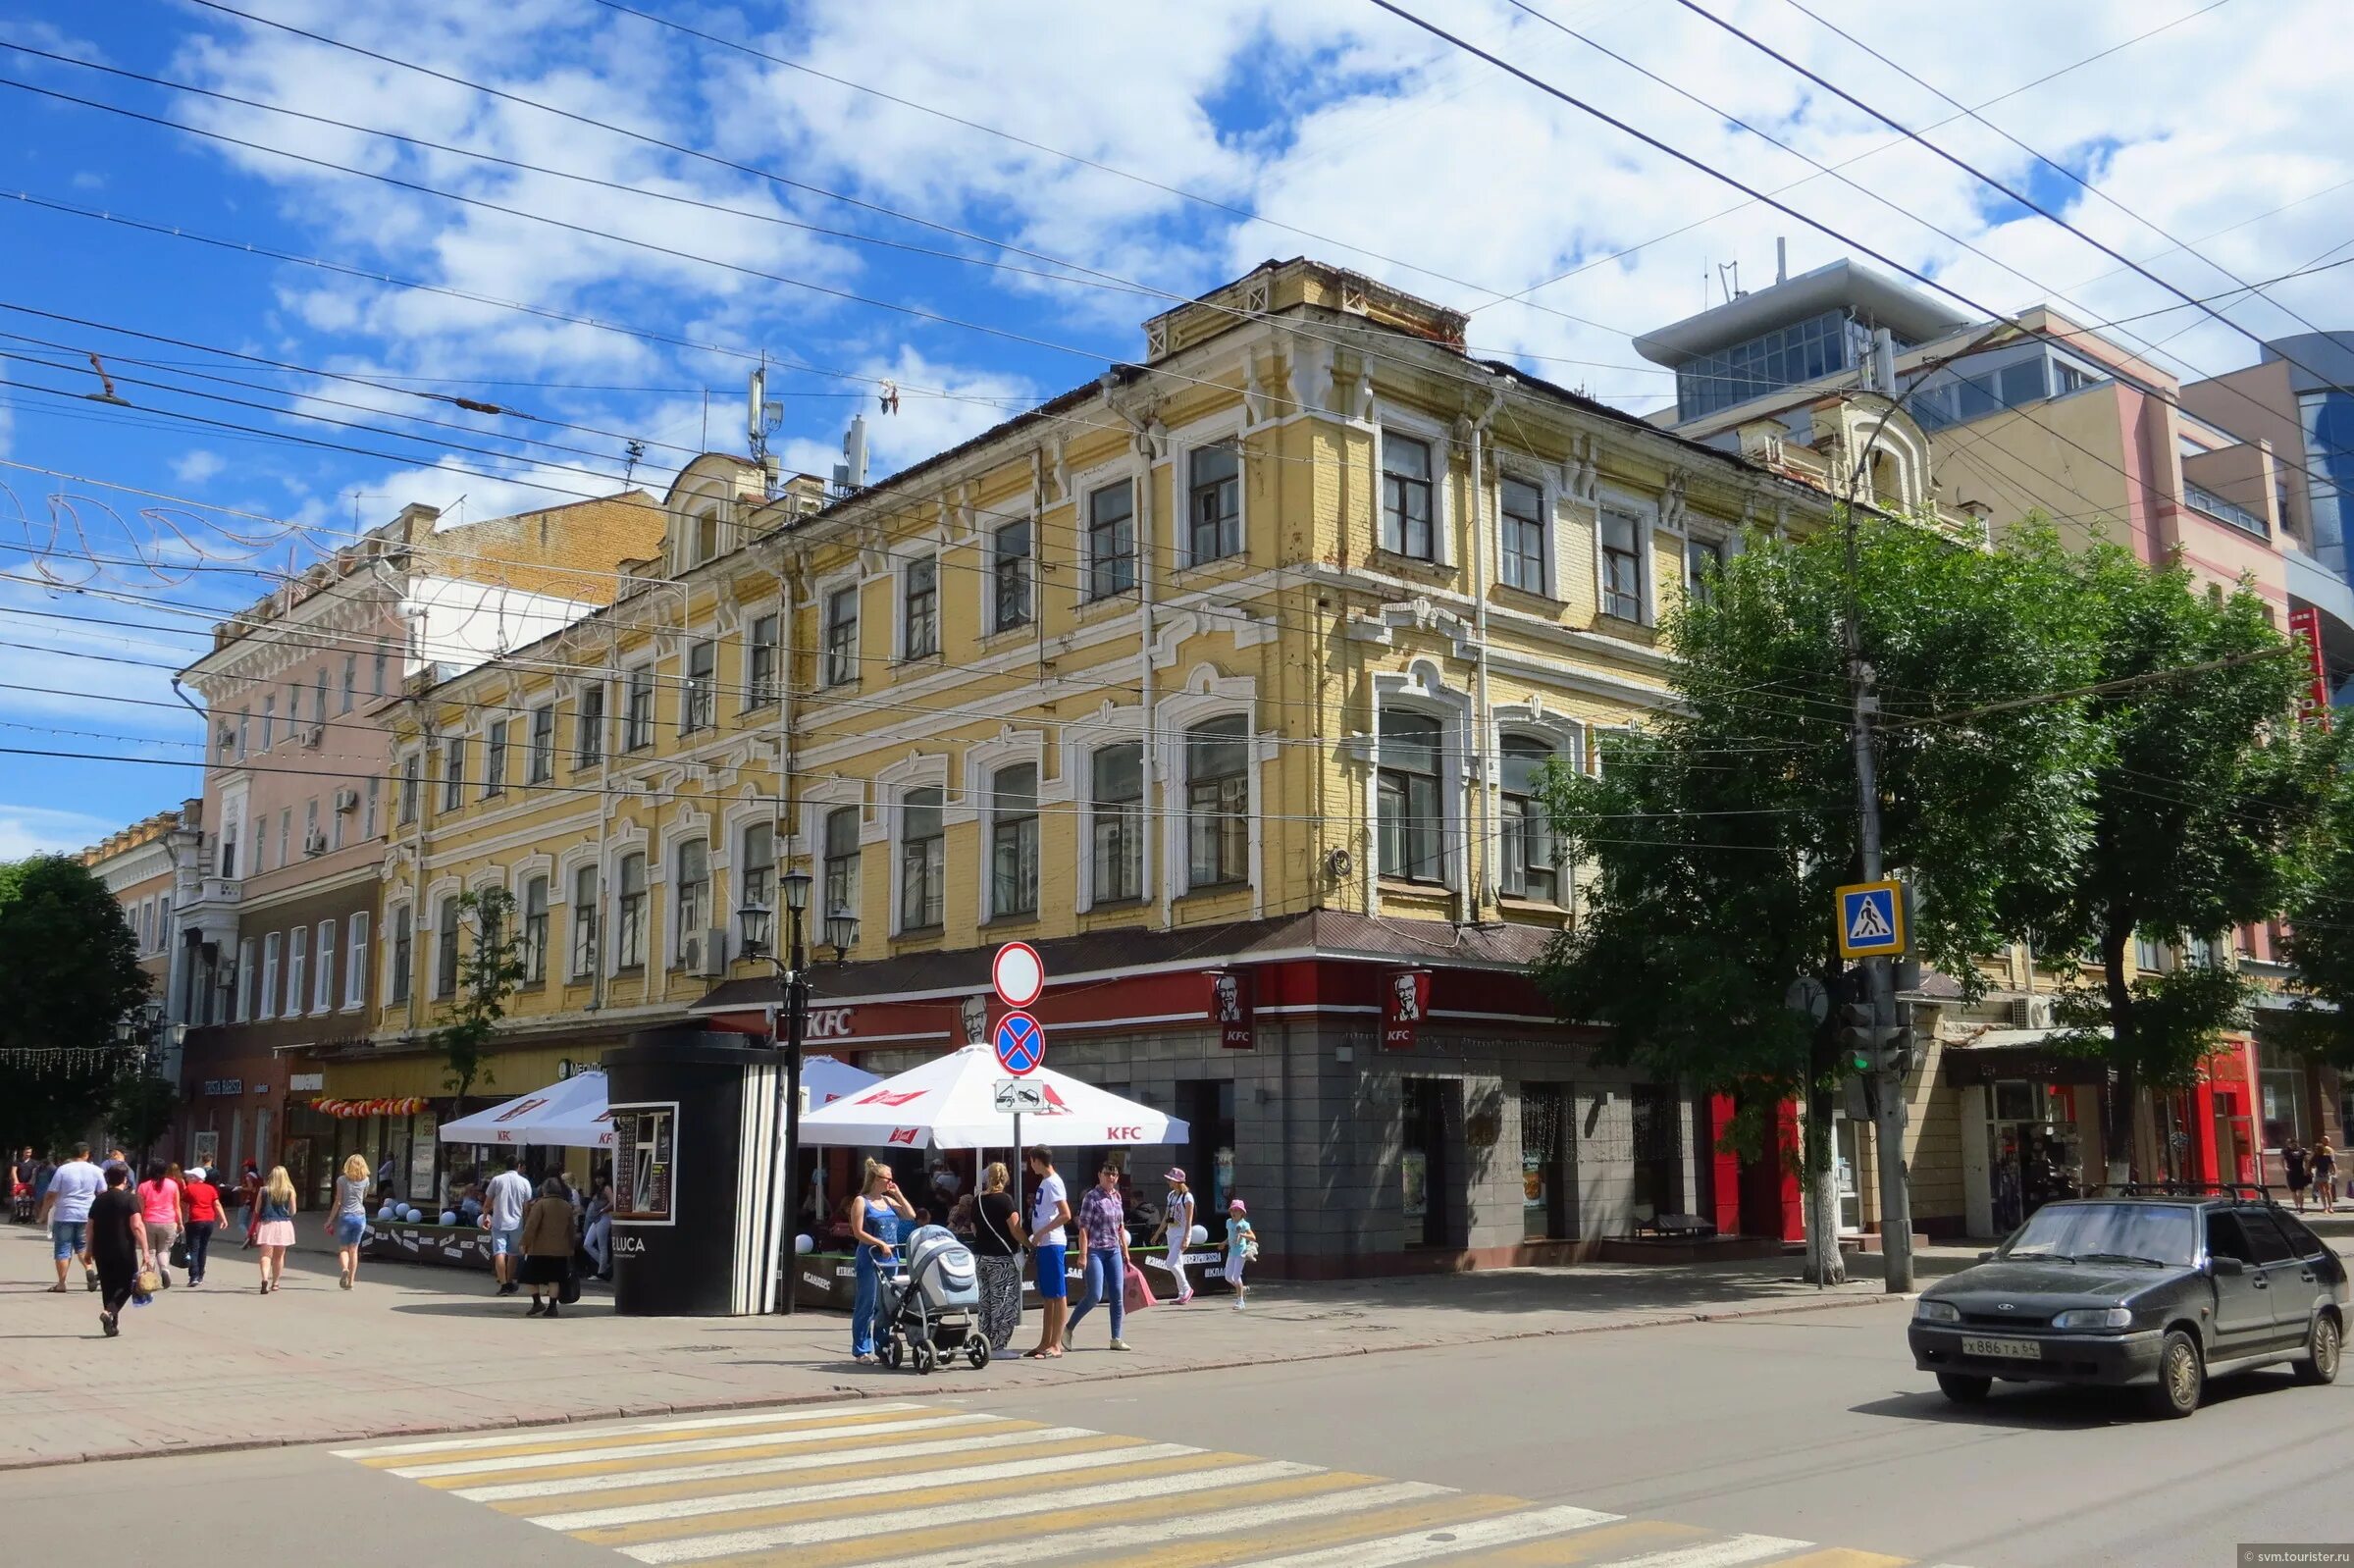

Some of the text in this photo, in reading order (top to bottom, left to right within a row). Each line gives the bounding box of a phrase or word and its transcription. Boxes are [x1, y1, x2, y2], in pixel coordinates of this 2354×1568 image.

[807, 1008, 852, 1037] KFC
[1228, 1031, 1249, 1041] KFC
[1387, 1030, 1409, 1040] KFC
[497, 1130, 511, 1141] KFC
[599, 1132, 613, 1143] KF
[1107, 1127, 1141, 1139] KFC
